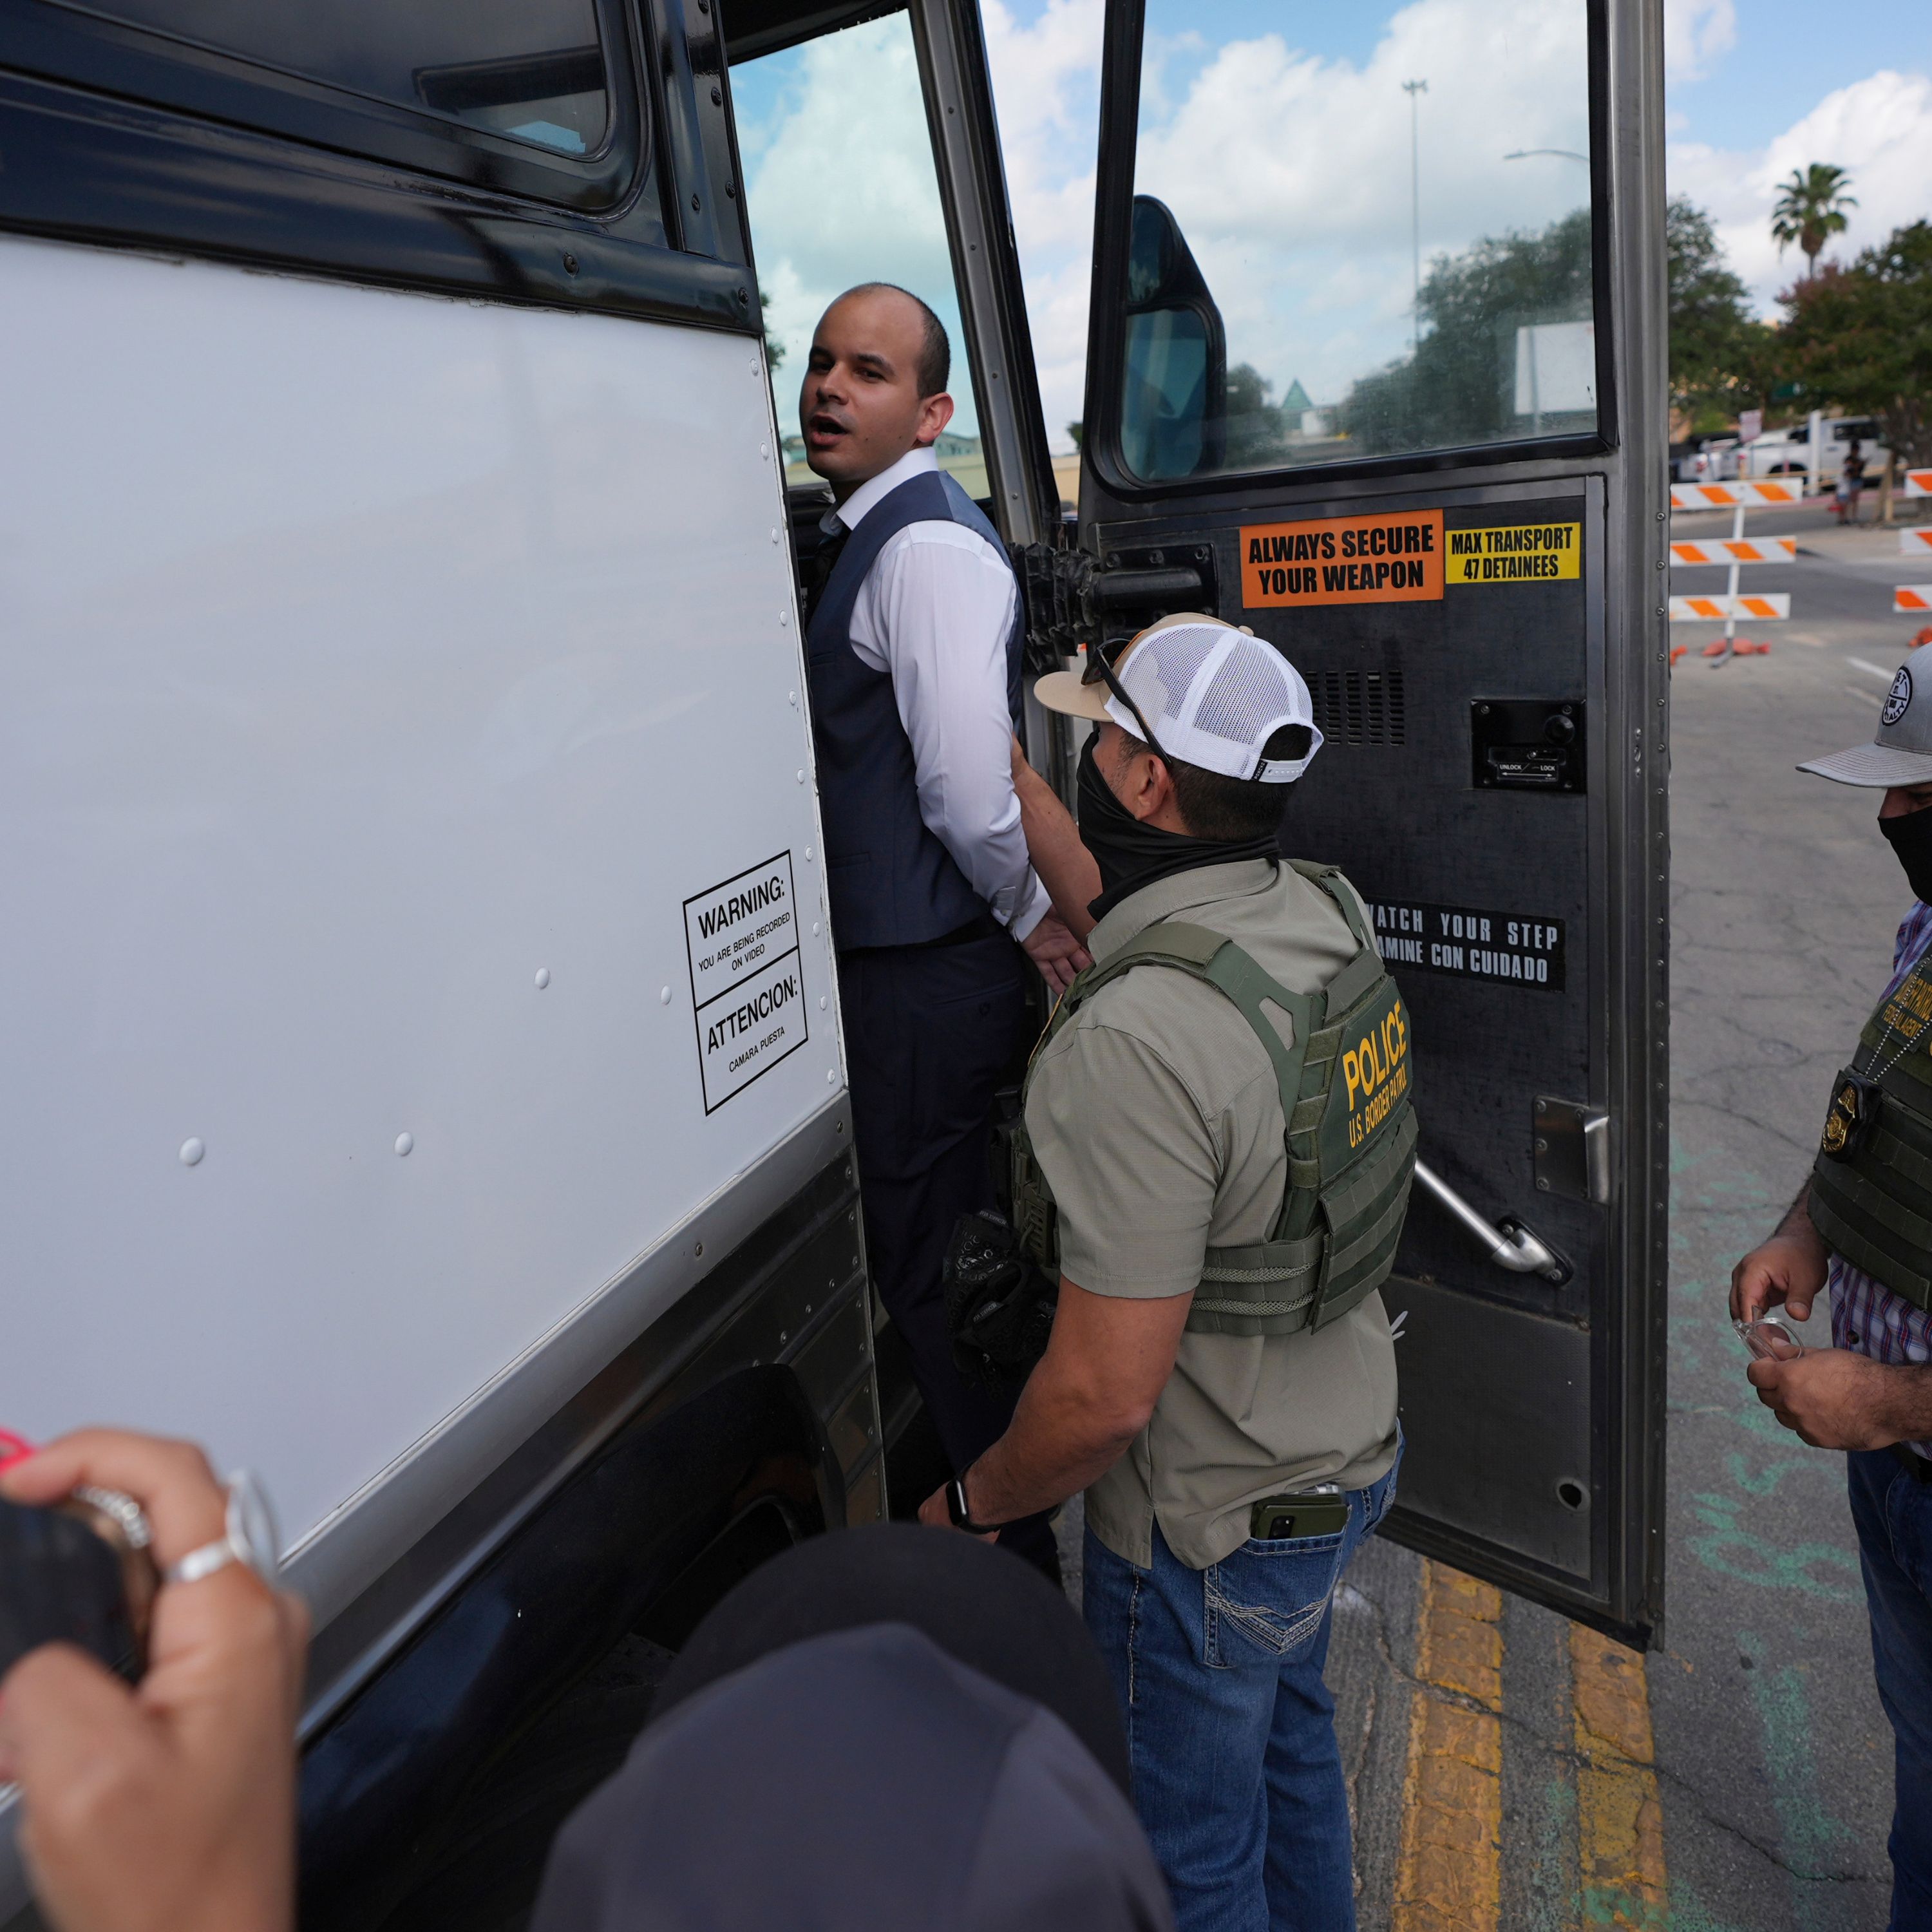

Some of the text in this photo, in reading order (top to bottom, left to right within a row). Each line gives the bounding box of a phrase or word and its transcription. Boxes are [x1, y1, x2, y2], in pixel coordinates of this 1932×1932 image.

[1249, 524, 1434, 564] ALWAYS SECURE
[1452, 527, 1573, 554] MAX TRANSPORT
[1258, 560, 1424, 595] YOUR WEAPON
[1463, 554, 1559, 580] 47 DETAINEES
[697, 876, 785, 939] WARNING:
[699, 912, 791, 972] YOU ARE BEING RECORDED
[1440, 913, 1491, 942] YOUR
[1508, 921, 1558, 951] STEP
[732, 943, 765, 971] ON VIDEO
[1376, 935, 1548, 983] AMINE CON CUIDADO
[708, 975, 799, 1055] ATTENCION:
[728, 1027, 785, 1073] CAMARA PUESTA
[1343, 999, 1406, 1112] POLICE
[1349, 1062, 1407, 1148] U.S. BORDER PATROL
